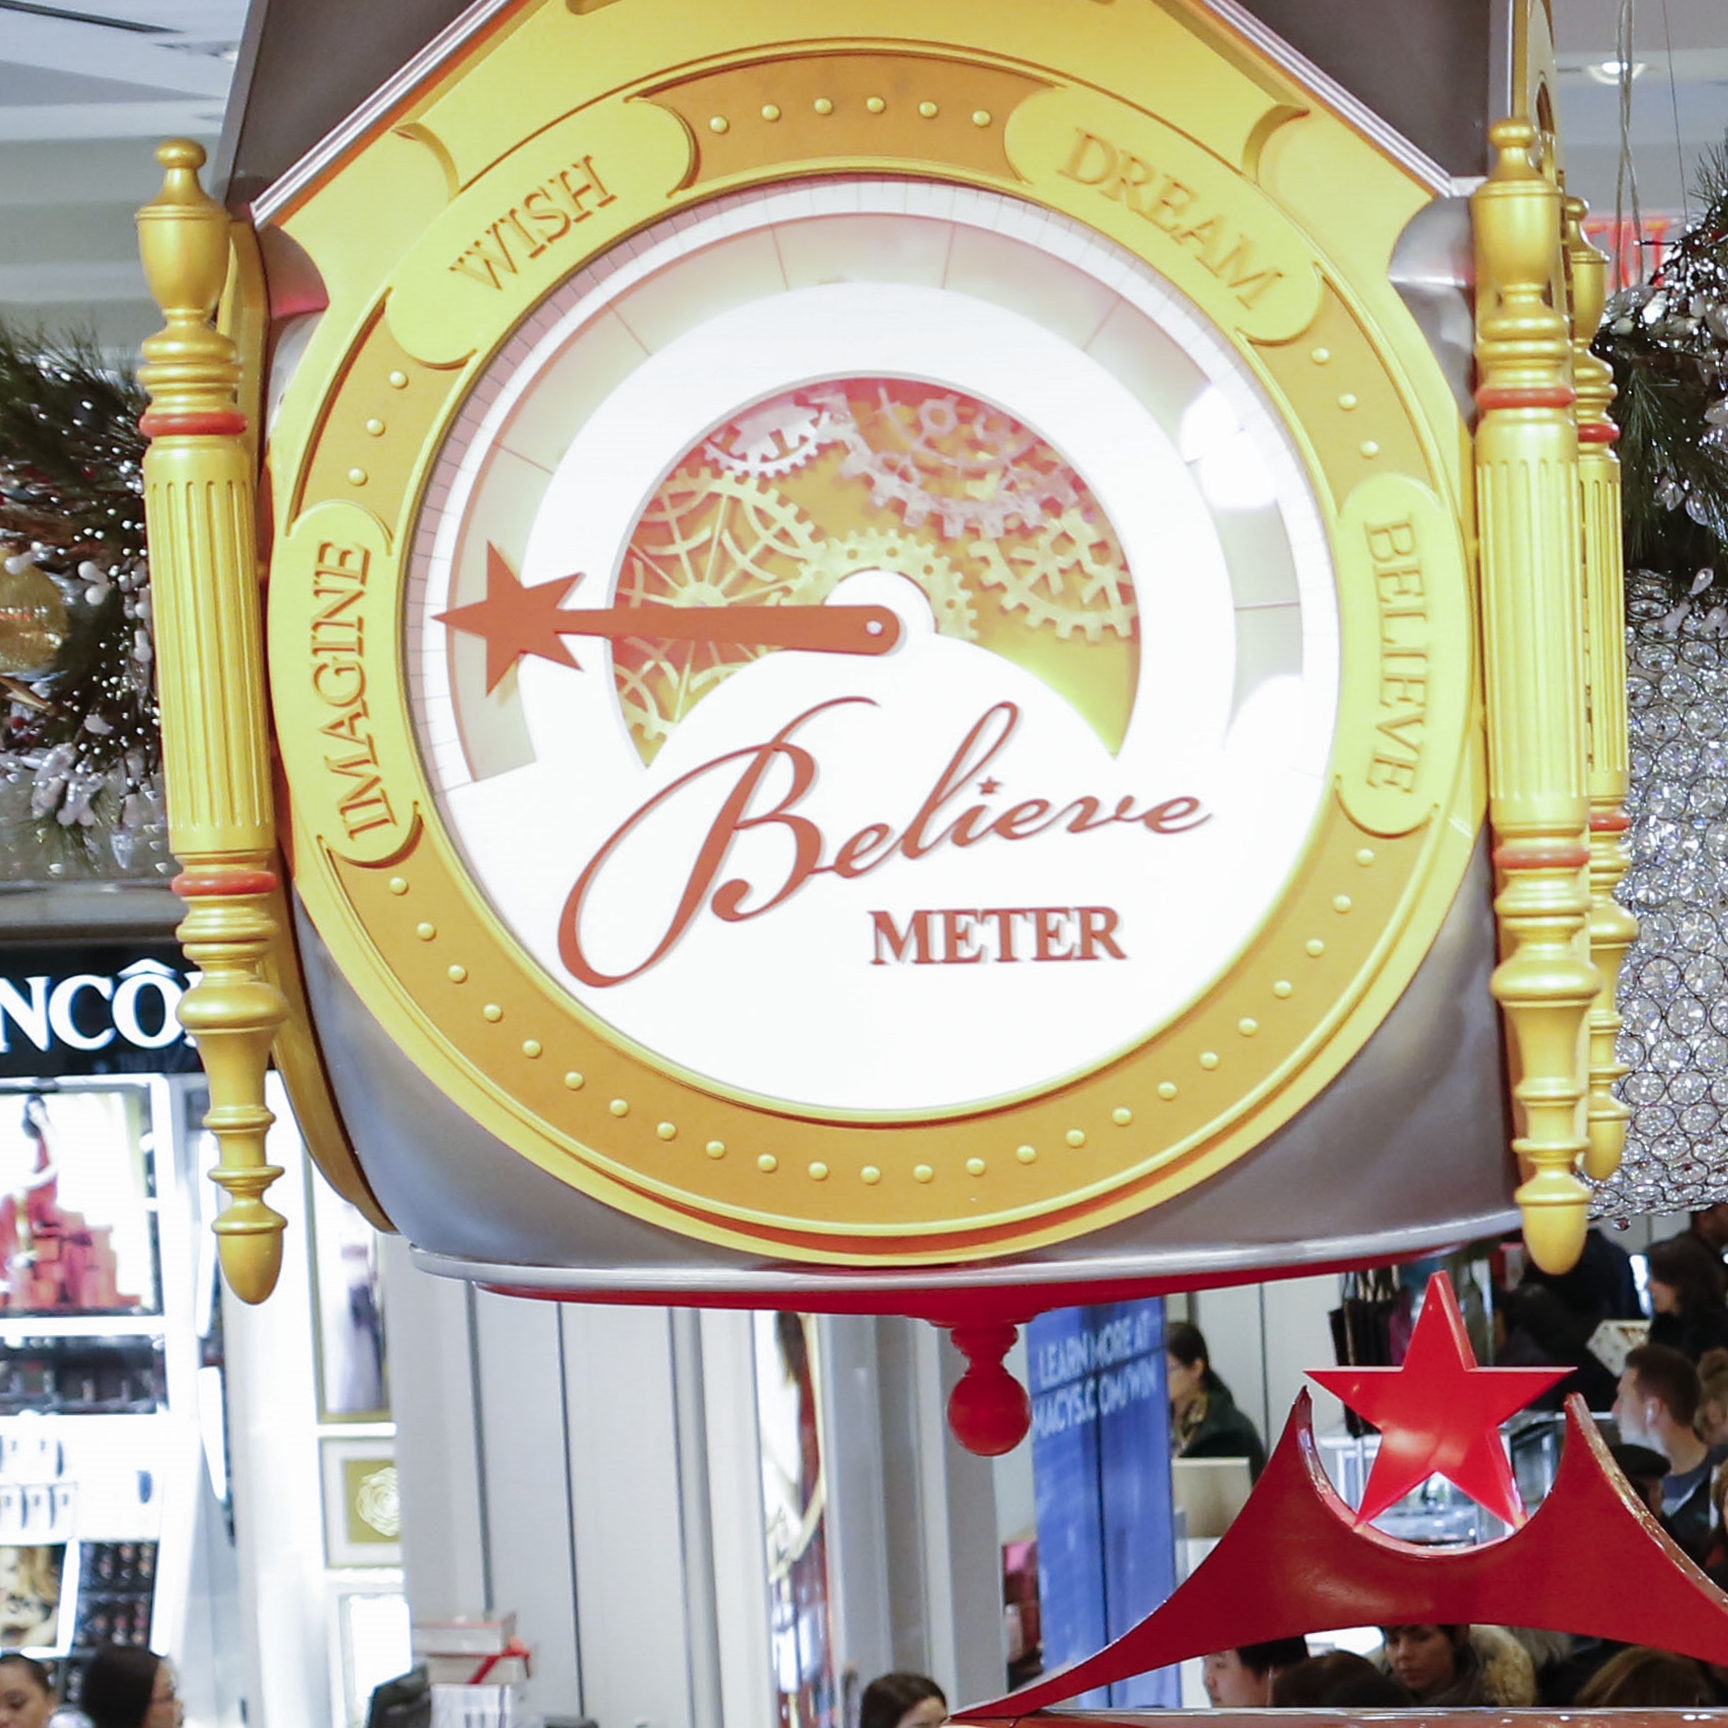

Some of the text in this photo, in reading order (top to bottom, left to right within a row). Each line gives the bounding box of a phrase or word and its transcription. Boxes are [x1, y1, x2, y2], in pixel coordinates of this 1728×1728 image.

[449, 155, 617, 291] WISH
[1056, 128, 1283, 310] DREAM
[311, 540, 397, 840] IMAGINE
[1363, 512, 1428, 794] BELIEVE
[557, 696, 1212, 988] Believe
[0, 958, 204, 1051] NCÔ
[868, 906, 1127, 966] METER
